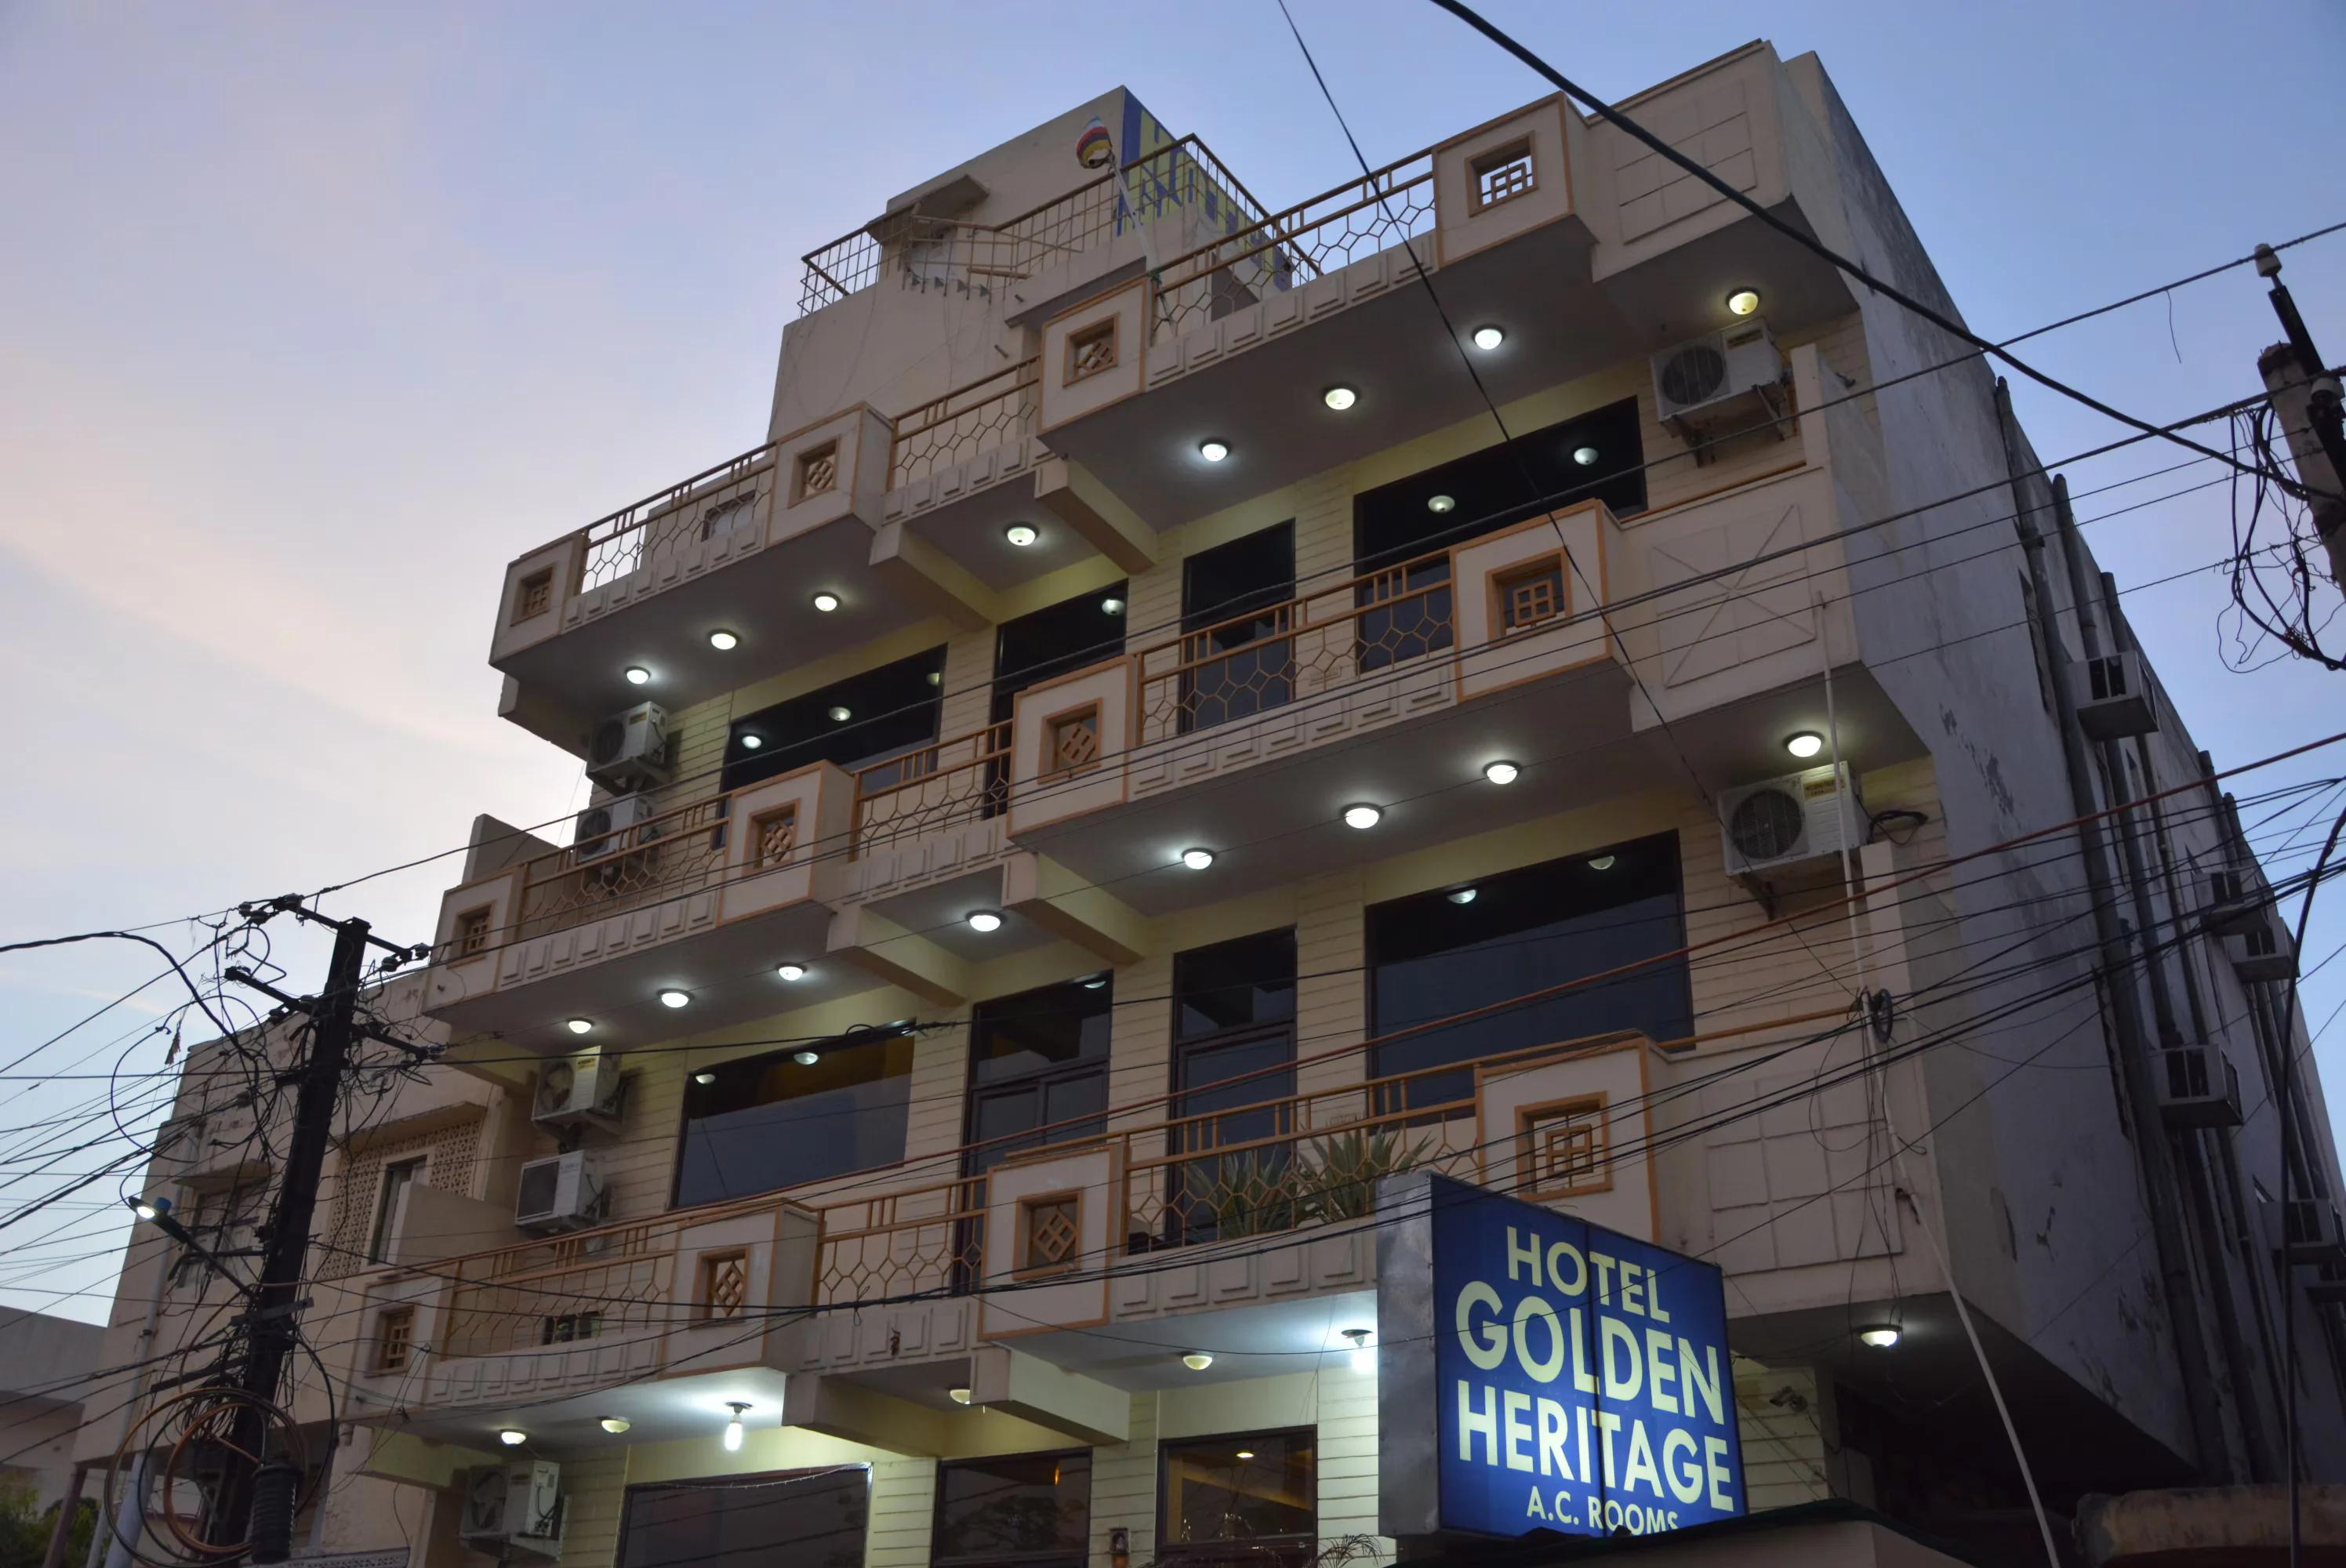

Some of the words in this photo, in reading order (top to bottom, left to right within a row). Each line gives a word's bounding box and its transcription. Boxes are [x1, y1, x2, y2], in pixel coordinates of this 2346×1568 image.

[1507, 1225, 1670, 1323] HOTEL
[1456, 1281, 1725, 1425] GOLDEN
[1458, 1379, 1734, 1512] HERITAGE
[1527, 1486, 1579, 1525] A.C.
